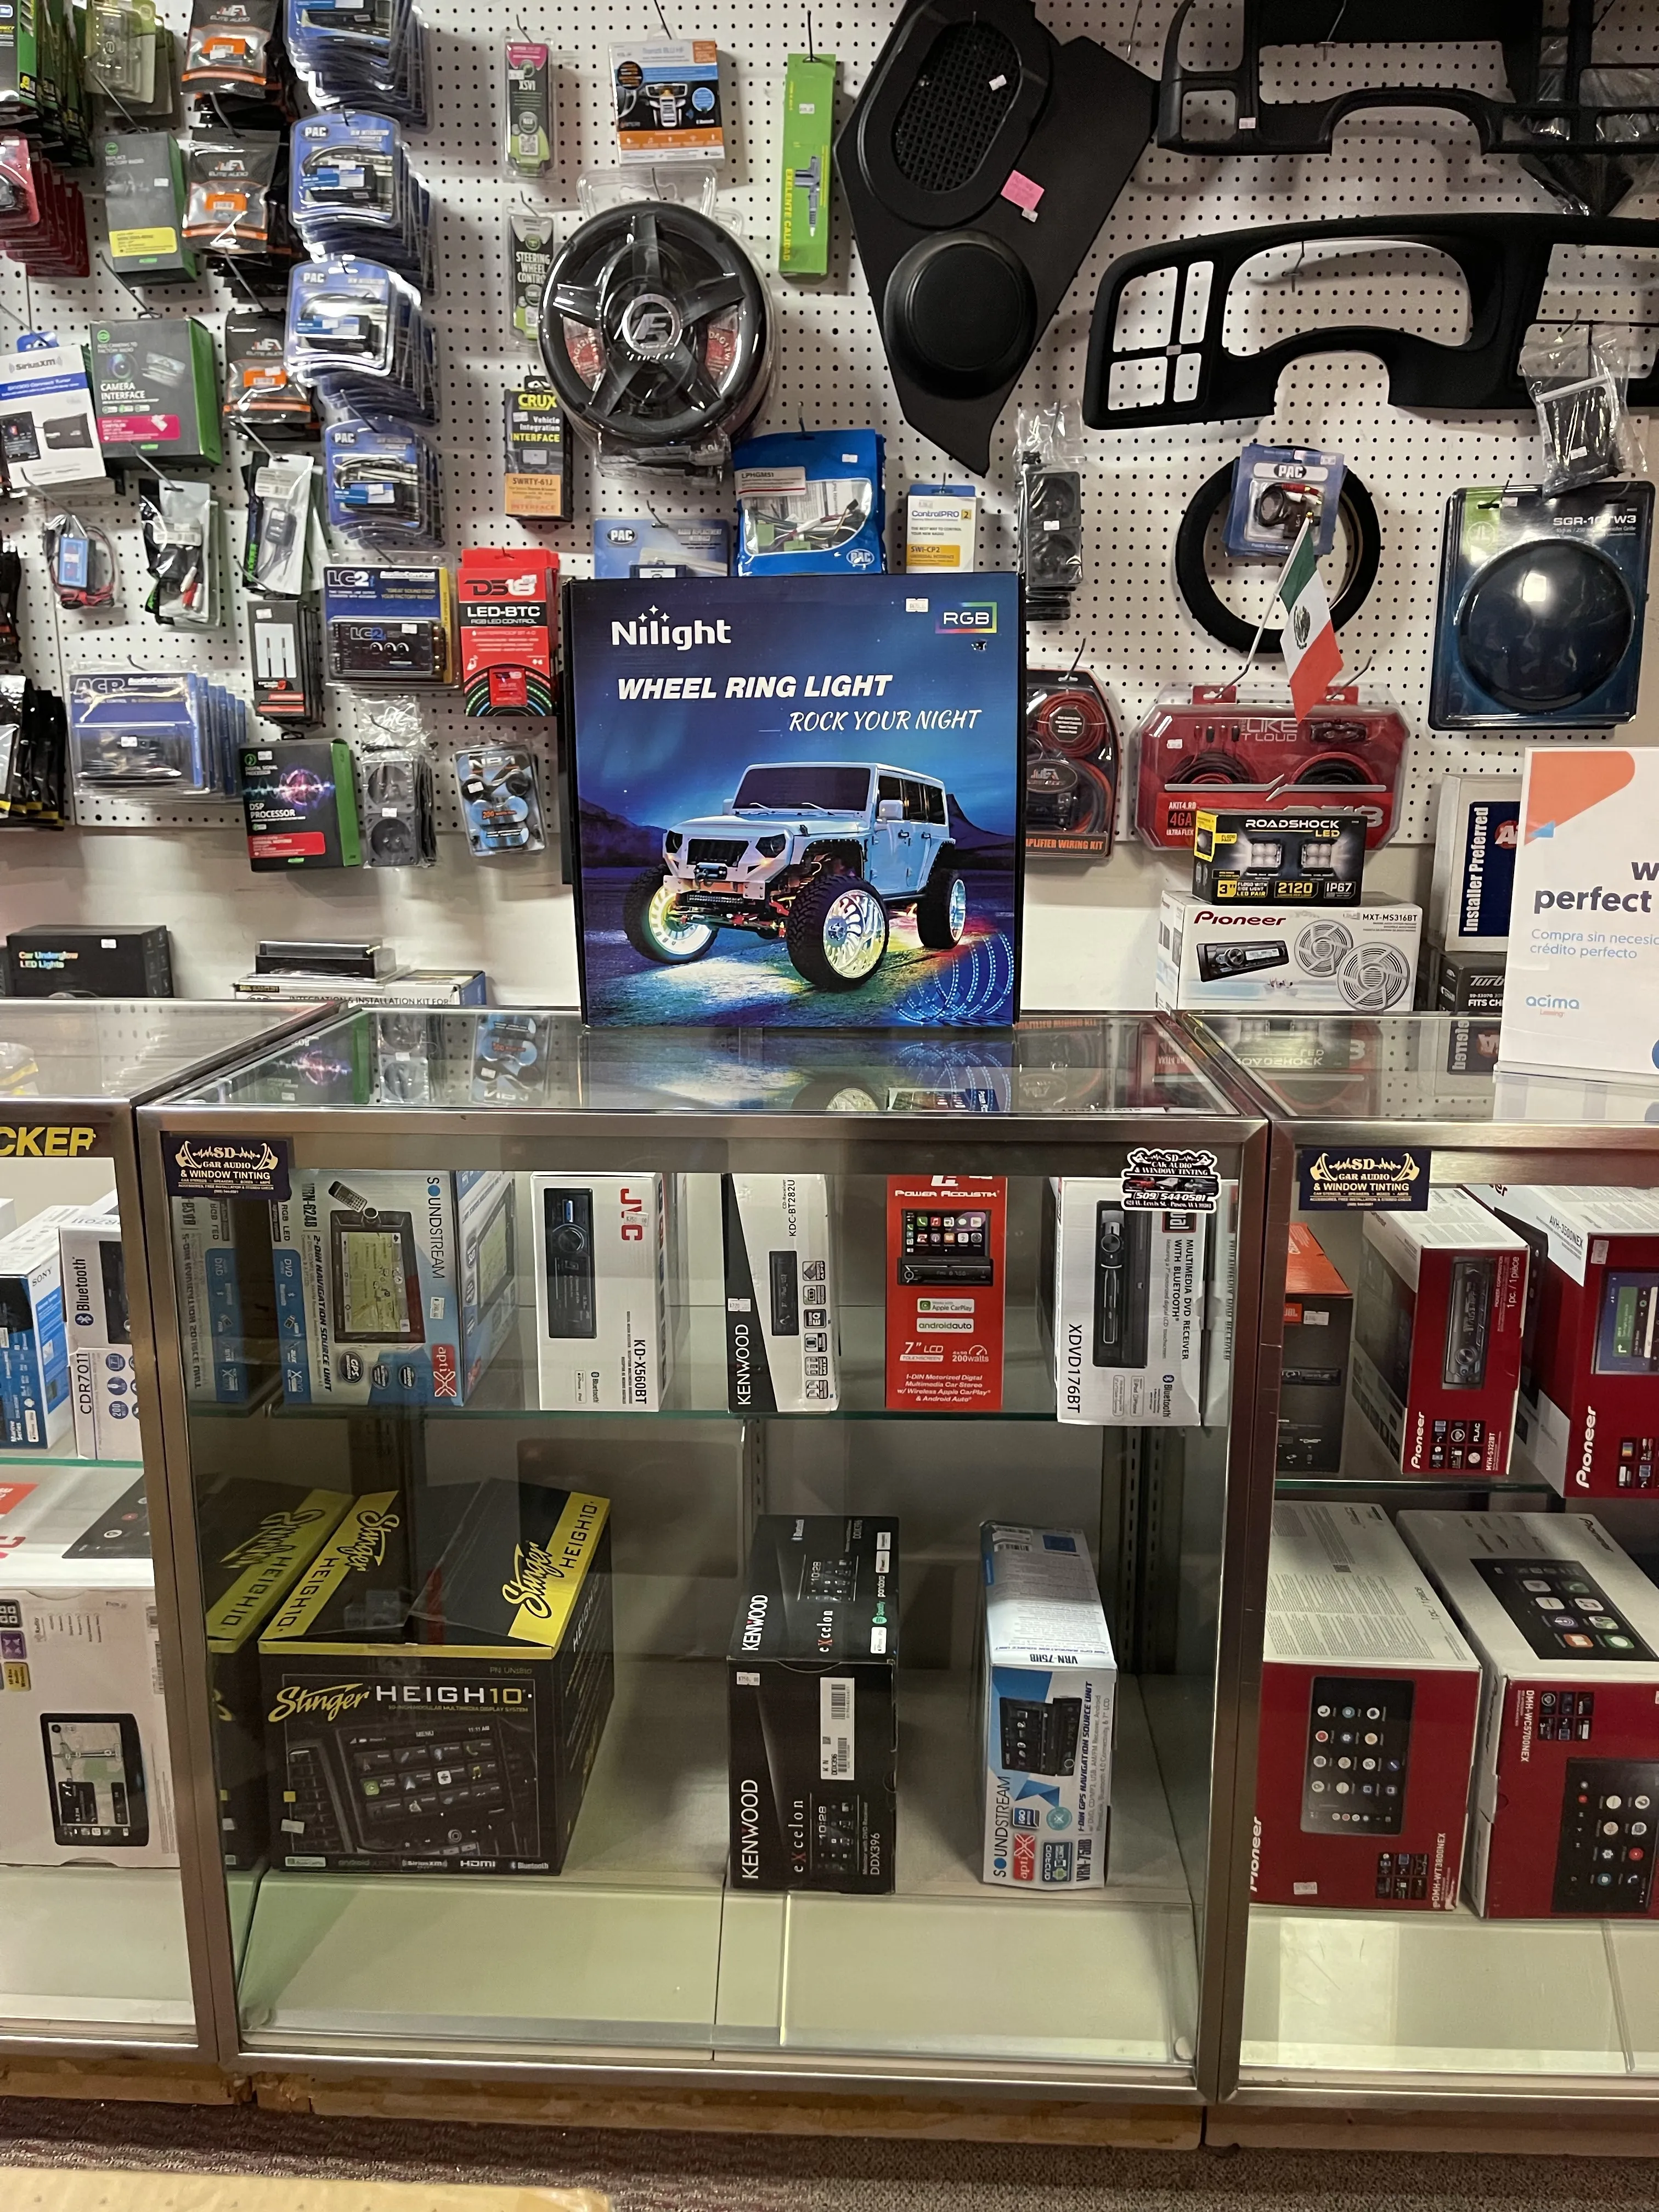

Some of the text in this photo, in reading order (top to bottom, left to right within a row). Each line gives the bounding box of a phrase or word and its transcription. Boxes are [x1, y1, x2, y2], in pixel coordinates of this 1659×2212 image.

[304, 126, 327, 137] PAC
[516, 251, 550, 264] STEERING
[521, 263, 548, 274] WHEEL
[303, 273, 325, 283] PAC
[100, 382, 136, 392] CAMERA
[101, 391, 146, 400] INTERFACE
[518, 393, 557, 408] CRUX
[533, 415, 560, 424] Vehicle
[520, 423, 560, 432] Integration
[334, 432, 356, 443] PAC
[1278, 465, 1304, 478] PAC
[911, 510, 969, 519] ControlPRO 2
[610, 530, 633, 541] PAC
[467, 606, 541, 618] LED-BTC
[943, 611, 991, 625] RGB
[611, 619, 732, 651] Nilight
[617, 674, 893, 701] WHEEL RING LIGHT
[788, 709, 983, 732] ROCK YOUR NIGHT
[249, 802, 265, 811] DSP
[250, 809, 296, 819] PROCESSOR
[1169, 811, 1193, 827] 4GA
[1245, 819, 1339, 829] ROADSHOCK
[1315, 830, 1340, 838] LED
[1058, 839, 1104, 850] WIRING KIT
[1463, 807, 1488, 932] Installer Preferred
[1278, 882, 1313, 894] 2120
[1326, 882, 1352, 893] IP67
[1534, 886, 1652, 915] perfect
[1194, 911, 1286, 926] Pioneer
[1362, 913, 1418, 922] MXT-MS316BT
[1531, 929, 1605, 943] Compra sin
[1530, 943, 1638, 959] crédito perfecto
[1525, 994, 1580, 1010] acima
[213, 1147, 236, 1159] SD
[1165, 1153, 1179, 1163] SD
[1351, 1158, 1375, 1170] SD
[189, 1170, 231, 1178] WINDOW
[233, 1171, 271, 1180] TINTING
[1313, 1183, 1410, 1192] & WINDOW TINTING
[1132, 1191, 1206, 1202] (509) 544-0581
[787, 1180, 797, 1237] KDC-BT282U
[281, 1204, 291, 1242] RGB LED
[427, 1176, 445, 1279] SOUNDSTREAM
[1174, 1239, 1182, 1262] WITH
[284, 1258, 293, 1278] DVD
[31, 1266, 53, 1288] SONY
[75, 1257, 90, 1311] Bluetooth
[1182, 1239, 1194, 1360] MULTIMEDIA DVD RECEIVER
[314, 1264, 332, 1392] NAVIGATION SOURCE UNIT
[918, 1322, 972, 1330] androidauto
[923, 1345, 944, 1353] LCD
[350, 1358, 360, 1378] GPS
[634, 1339, 647, 1404] KD-X560BT
[735, 1323, 752, 1406] KENWOOD
[1067, 1323, 1083, 1414] XDVD176BT
[80, 1352, 93, 1415] CDR7011
[1163, 1384, 1172, 1418] Bluetooth
[111, 1402, 121, 1417] 200
[1410, 1411, 1426, 1470] Pioneer
[1576, 1405, 1597, 1488] Pioneer
[741, 1594, 769, 1651] KENWOOD
[375, 1685, 523, 1704] HEIGH10
[1084, 1680, 1093, 1703] UNIT
[267, 1683, 371, 1723] Stinger
[1082, 1705, 1091, 1739] SOURCE
[1520, 1689, 1535, 1763] DMH-WC5700NEX
[1080, 1739, 1090, 1792] NAVIGATION
[741, 1779, 759, 1879] KENWOOD
[993, 1776, 1012, 1878] SOUNDSTREAM
[870, 1832, 881, 1876] DDX396
[460, 1860, 496, 1868] HDMI
[517, 1861, 549, 1870] Bluetooth
